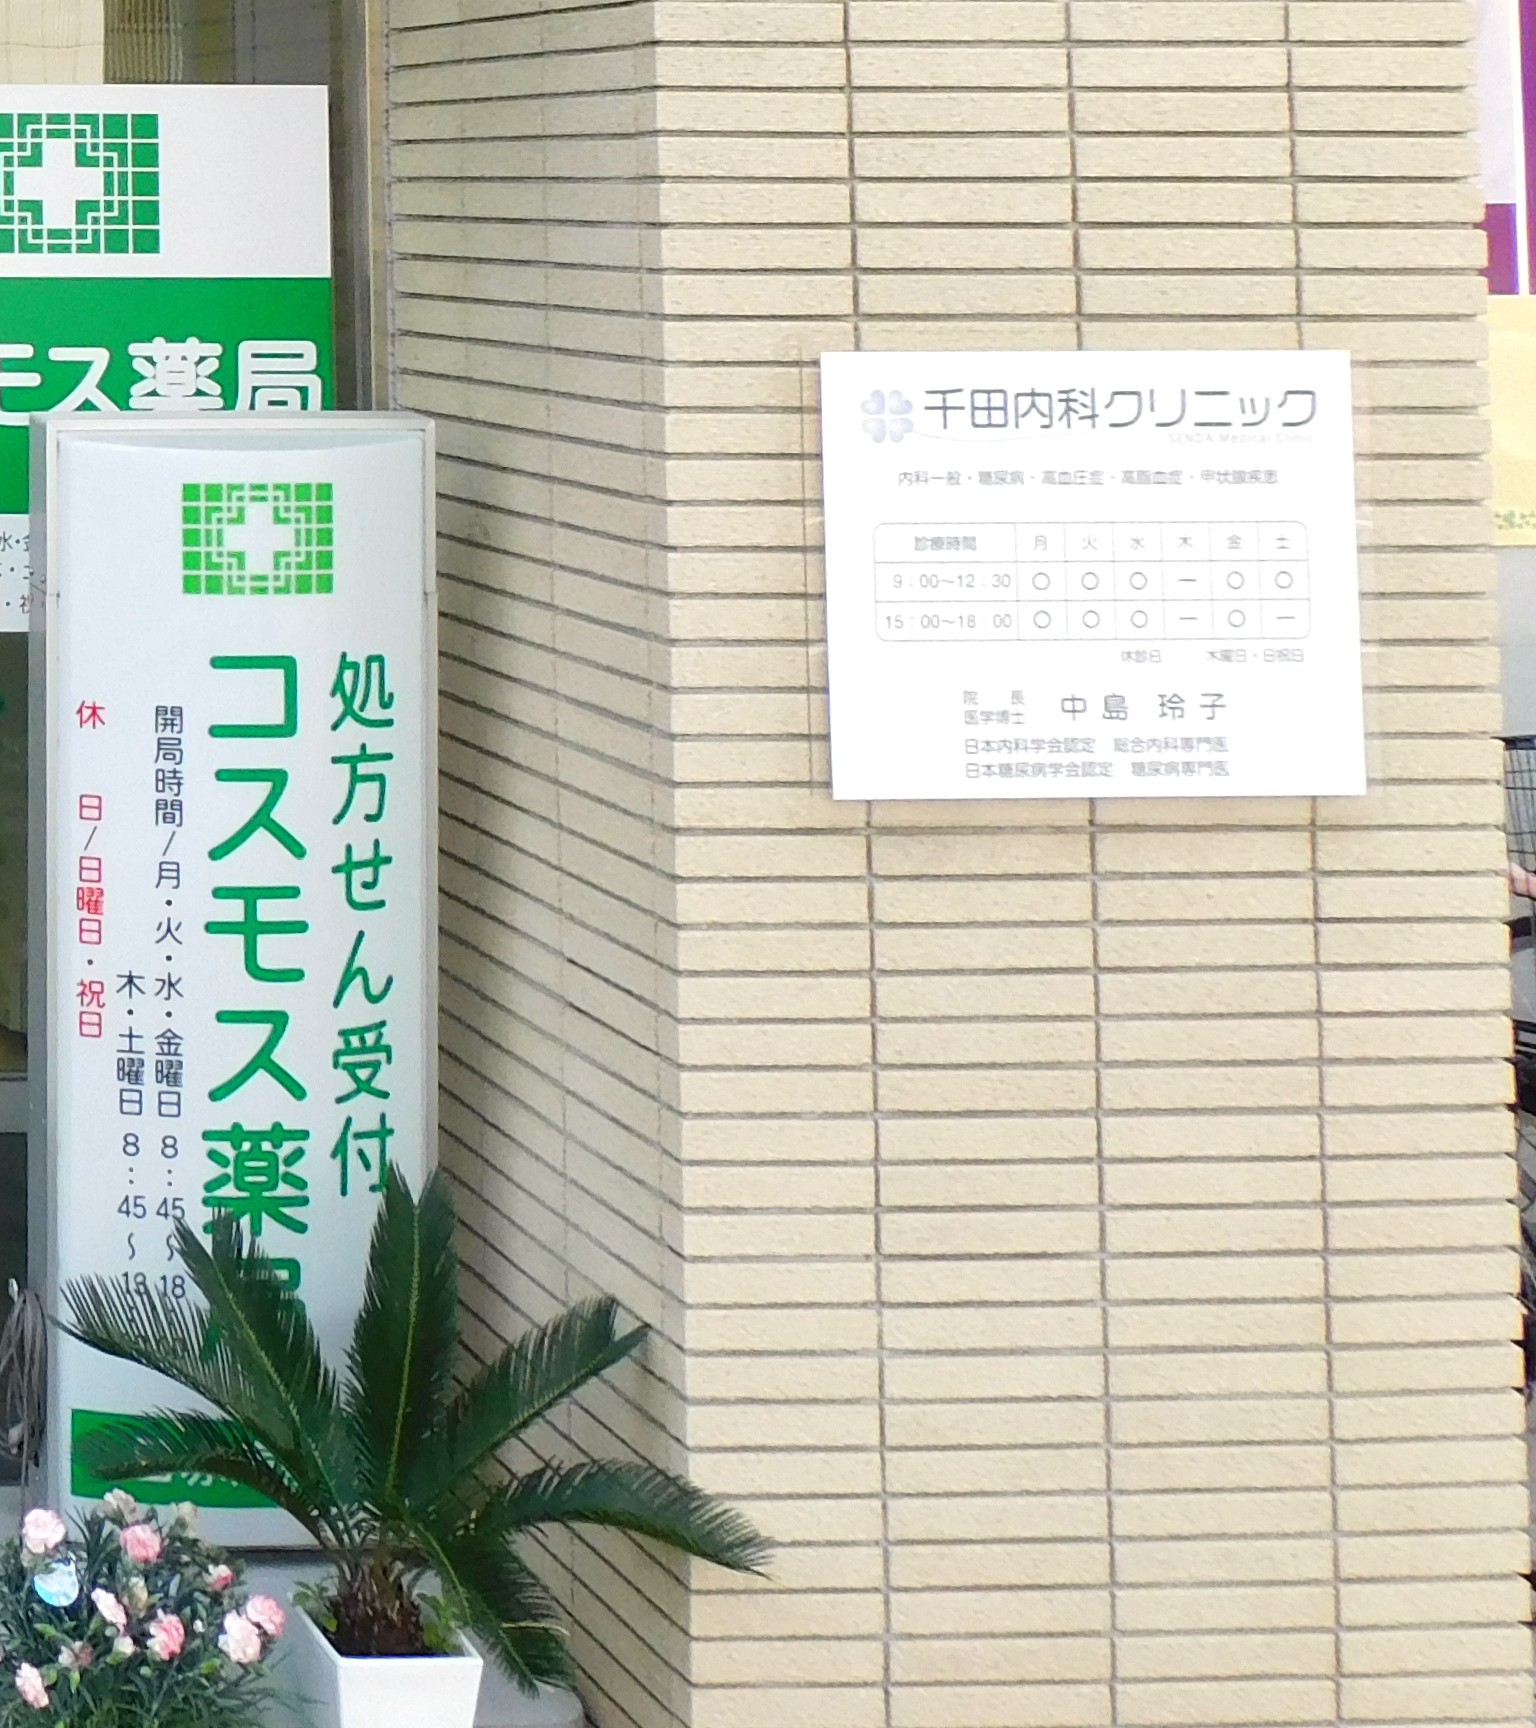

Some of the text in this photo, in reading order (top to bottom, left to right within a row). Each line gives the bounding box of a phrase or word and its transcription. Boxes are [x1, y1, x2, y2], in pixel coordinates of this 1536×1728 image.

[924, 388, 1316, 429] 千田内科クリニック
[330, 651, 394, 1196] 処方せん受付
